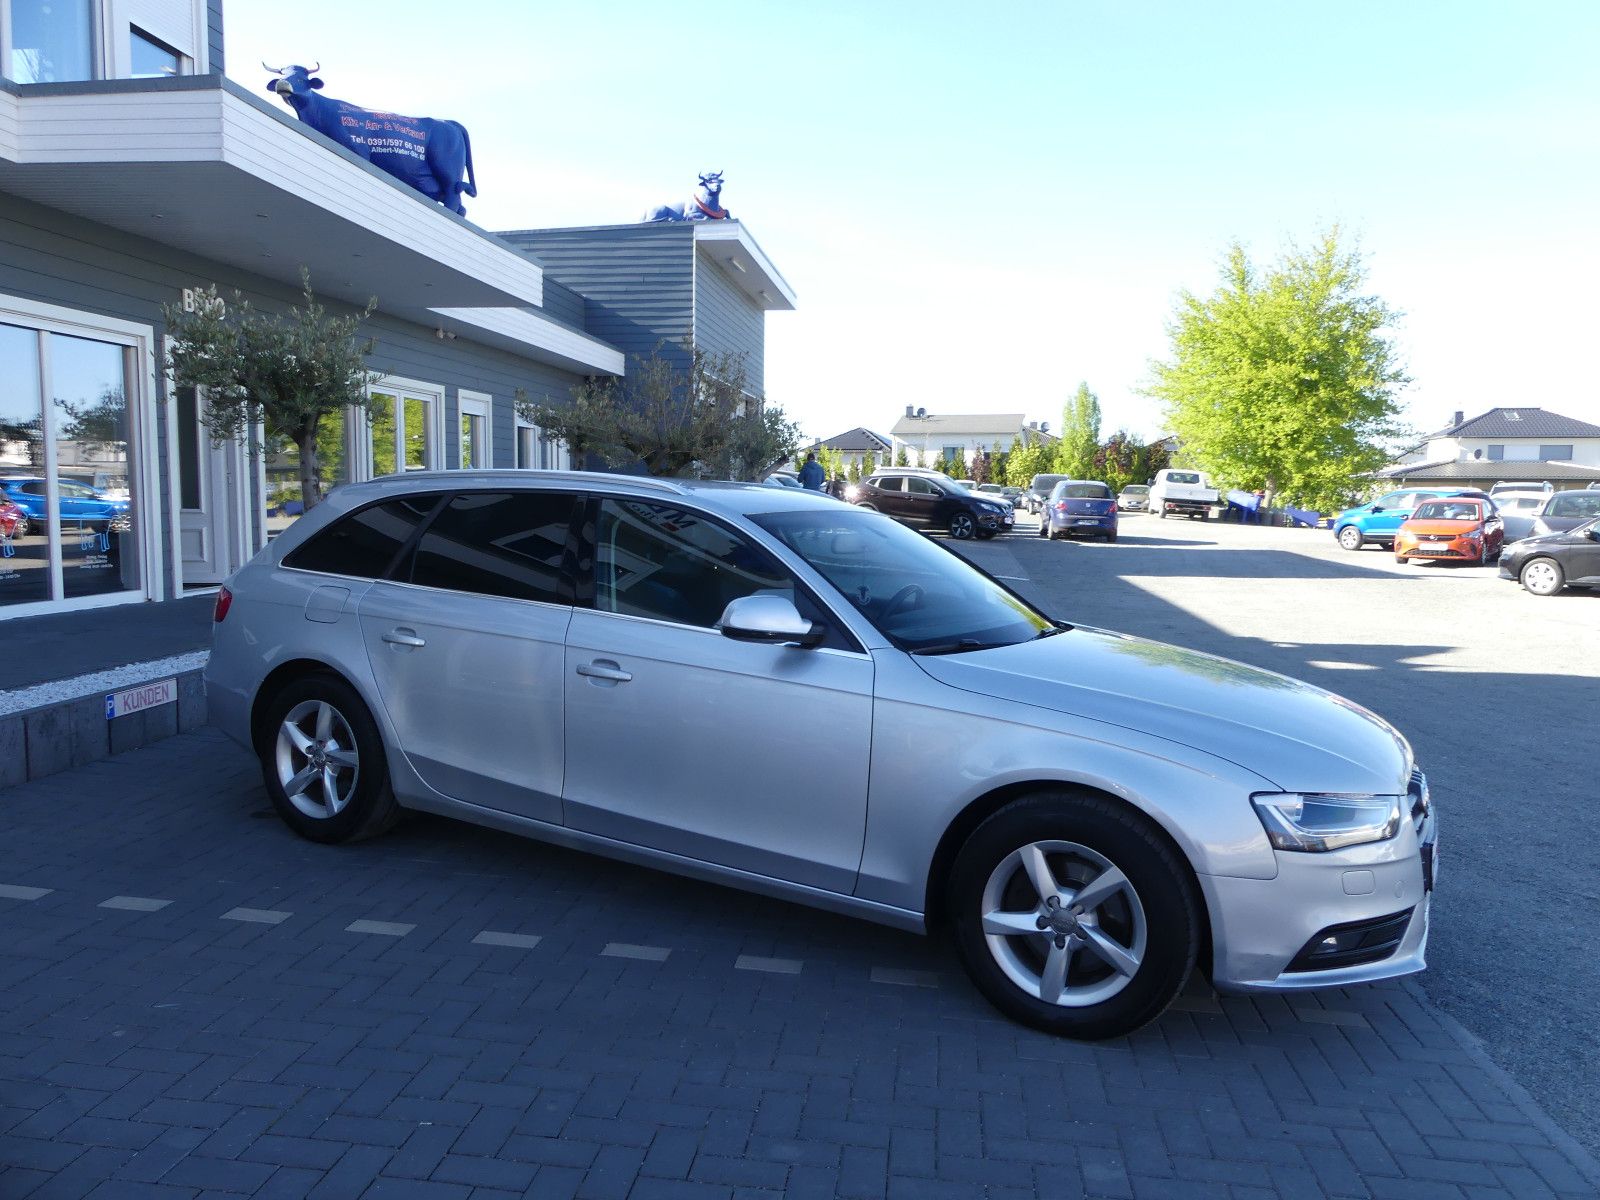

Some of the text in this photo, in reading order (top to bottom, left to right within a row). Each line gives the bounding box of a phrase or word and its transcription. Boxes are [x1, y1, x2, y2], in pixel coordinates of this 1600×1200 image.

[351, 135, 366, 144] Tel.
[367, 138, 402, 147] 0391/597
[123, 684, 169, 711] KUNDEN
